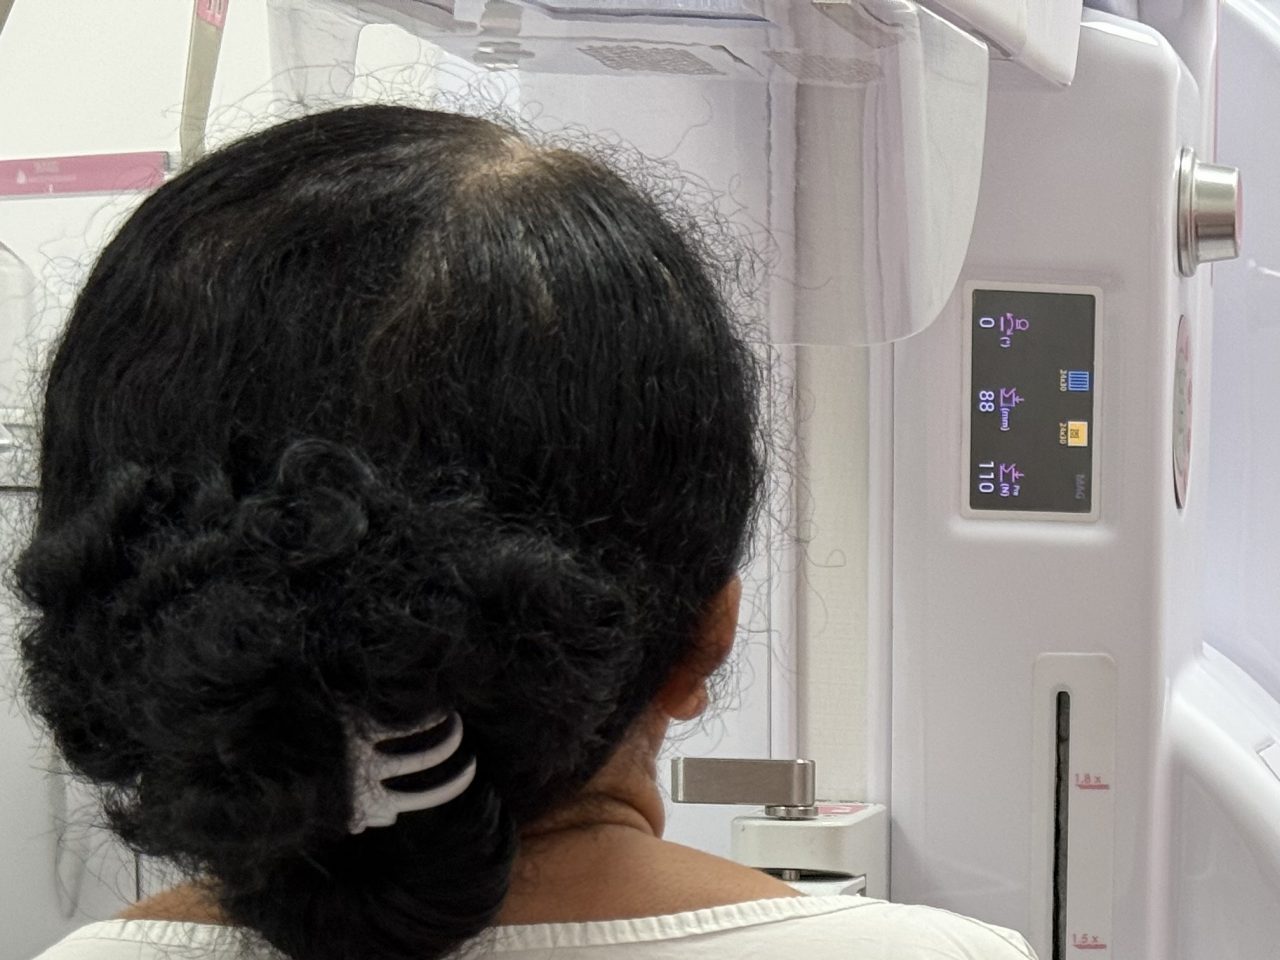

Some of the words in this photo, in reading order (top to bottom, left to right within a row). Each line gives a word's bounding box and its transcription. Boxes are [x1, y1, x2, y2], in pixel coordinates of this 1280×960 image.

[979, 317, 995, 328] 0
[979, 390, 995, 412] 88
[1000, 407, 1010, 431] (mm)
[979, 461, 995, 493] 110
[1000, 483, 1010, 497] (N)
